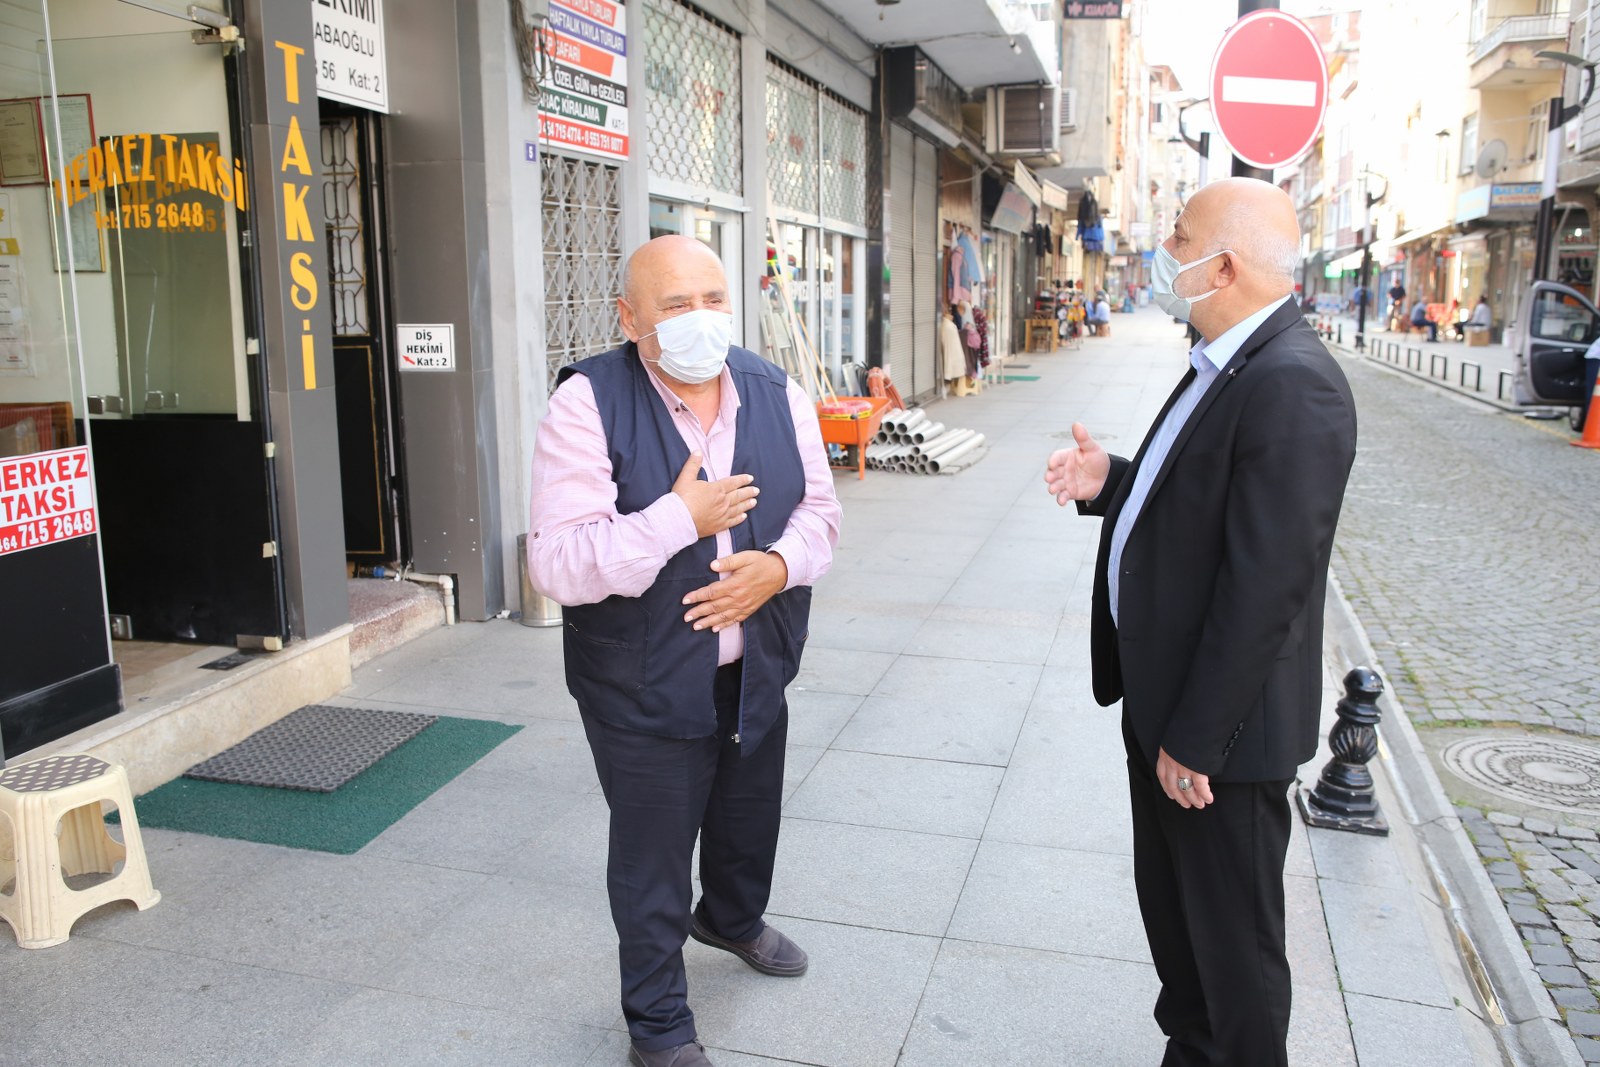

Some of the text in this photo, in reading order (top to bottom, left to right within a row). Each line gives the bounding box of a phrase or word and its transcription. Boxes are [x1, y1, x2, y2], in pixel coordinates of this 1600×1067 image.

[580, 21, 600, 43] YAYLA
[600, 28, 625, 53] TURLARI
[322, 60, 381, 93] 56 Kat: 2
[554, 65, 625, 105] ÖZEL GÜN ve GEZİLER
[561, 95, 600, 122] KİRALAMA
[122, 203, 151, 229] 715
[155, 201, 204, 228] 2648
[406, 343, 443, 354] HEKİMİ
[415, 329, 433, 342] DİŞ
[441, 357, 447, 366] 2
[0, 453, 88, 493] ERKEZ
[18, 520, 49, 547] 715
[53, 510, 93, 540] 2648
